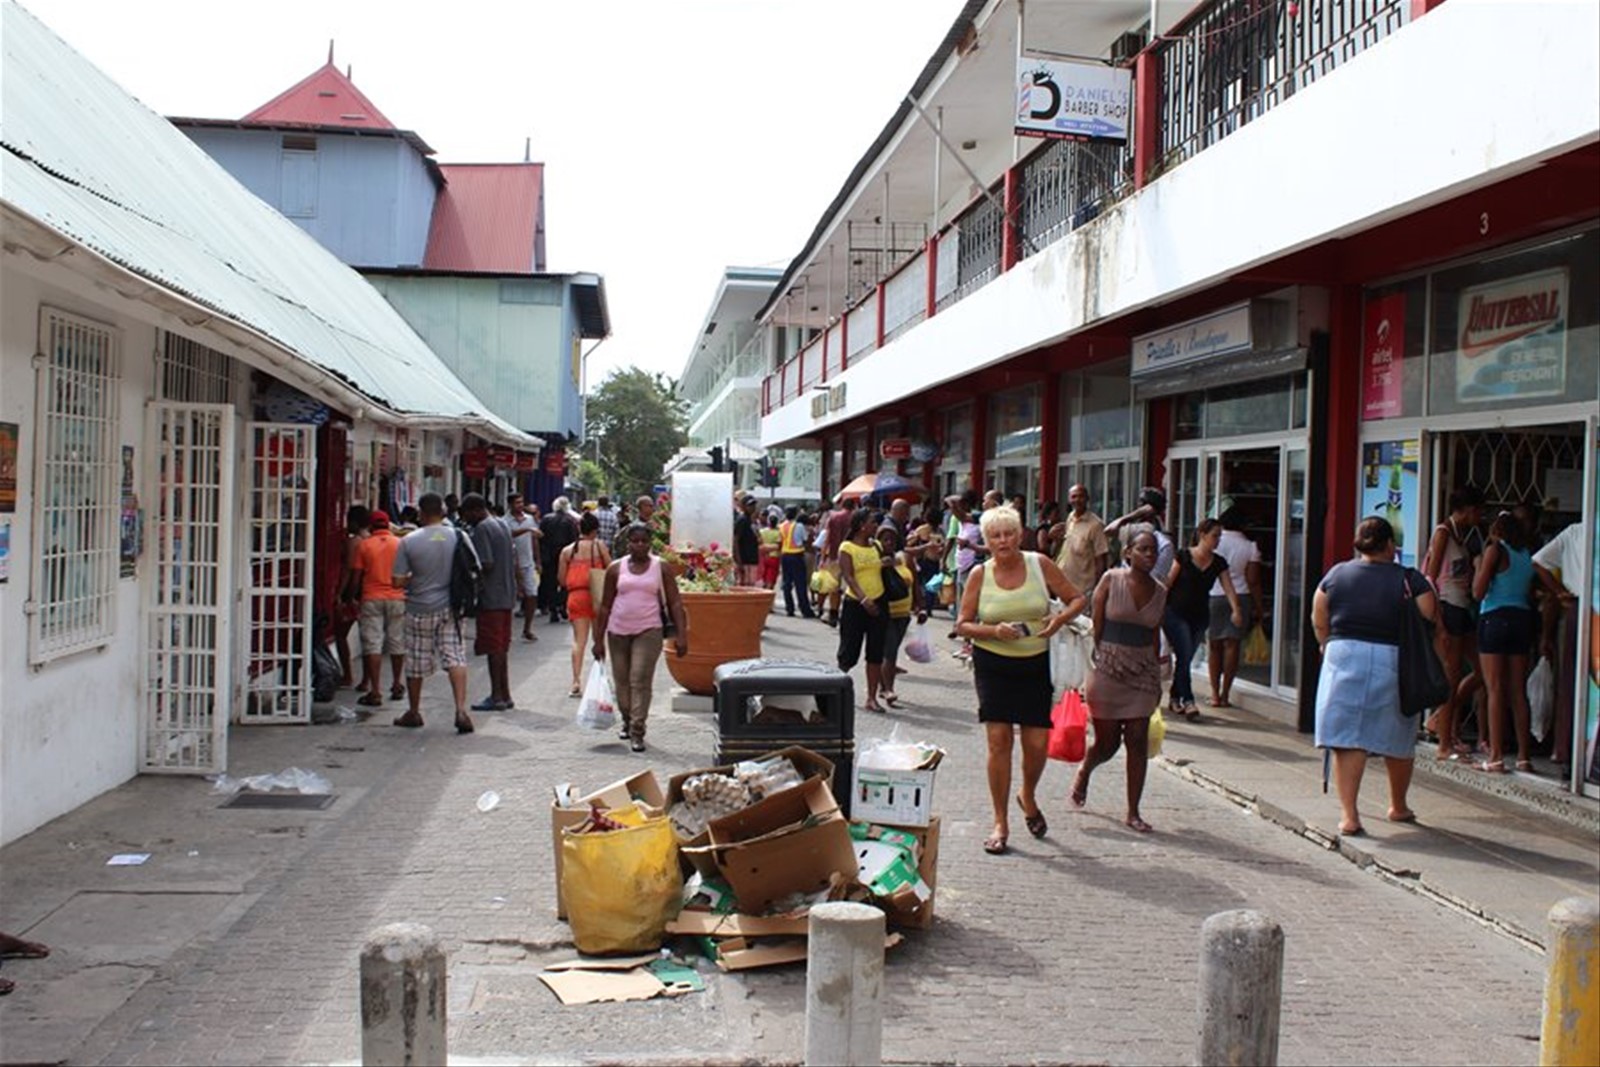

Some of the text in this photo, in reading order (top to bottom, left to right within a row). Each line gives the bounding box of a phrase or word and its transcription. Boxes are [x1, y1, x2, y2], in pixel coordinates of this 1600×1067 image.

[1065, 86, 1128, 104] DANIEL'S
[1065, 100, 1128, 118] BARBER SHOP
[1480, 212, 1489, 235] 3
[1465, 288, 1560, 333] UNIVERSAL
[1502, 365, 1558, 384] MERCHANT
